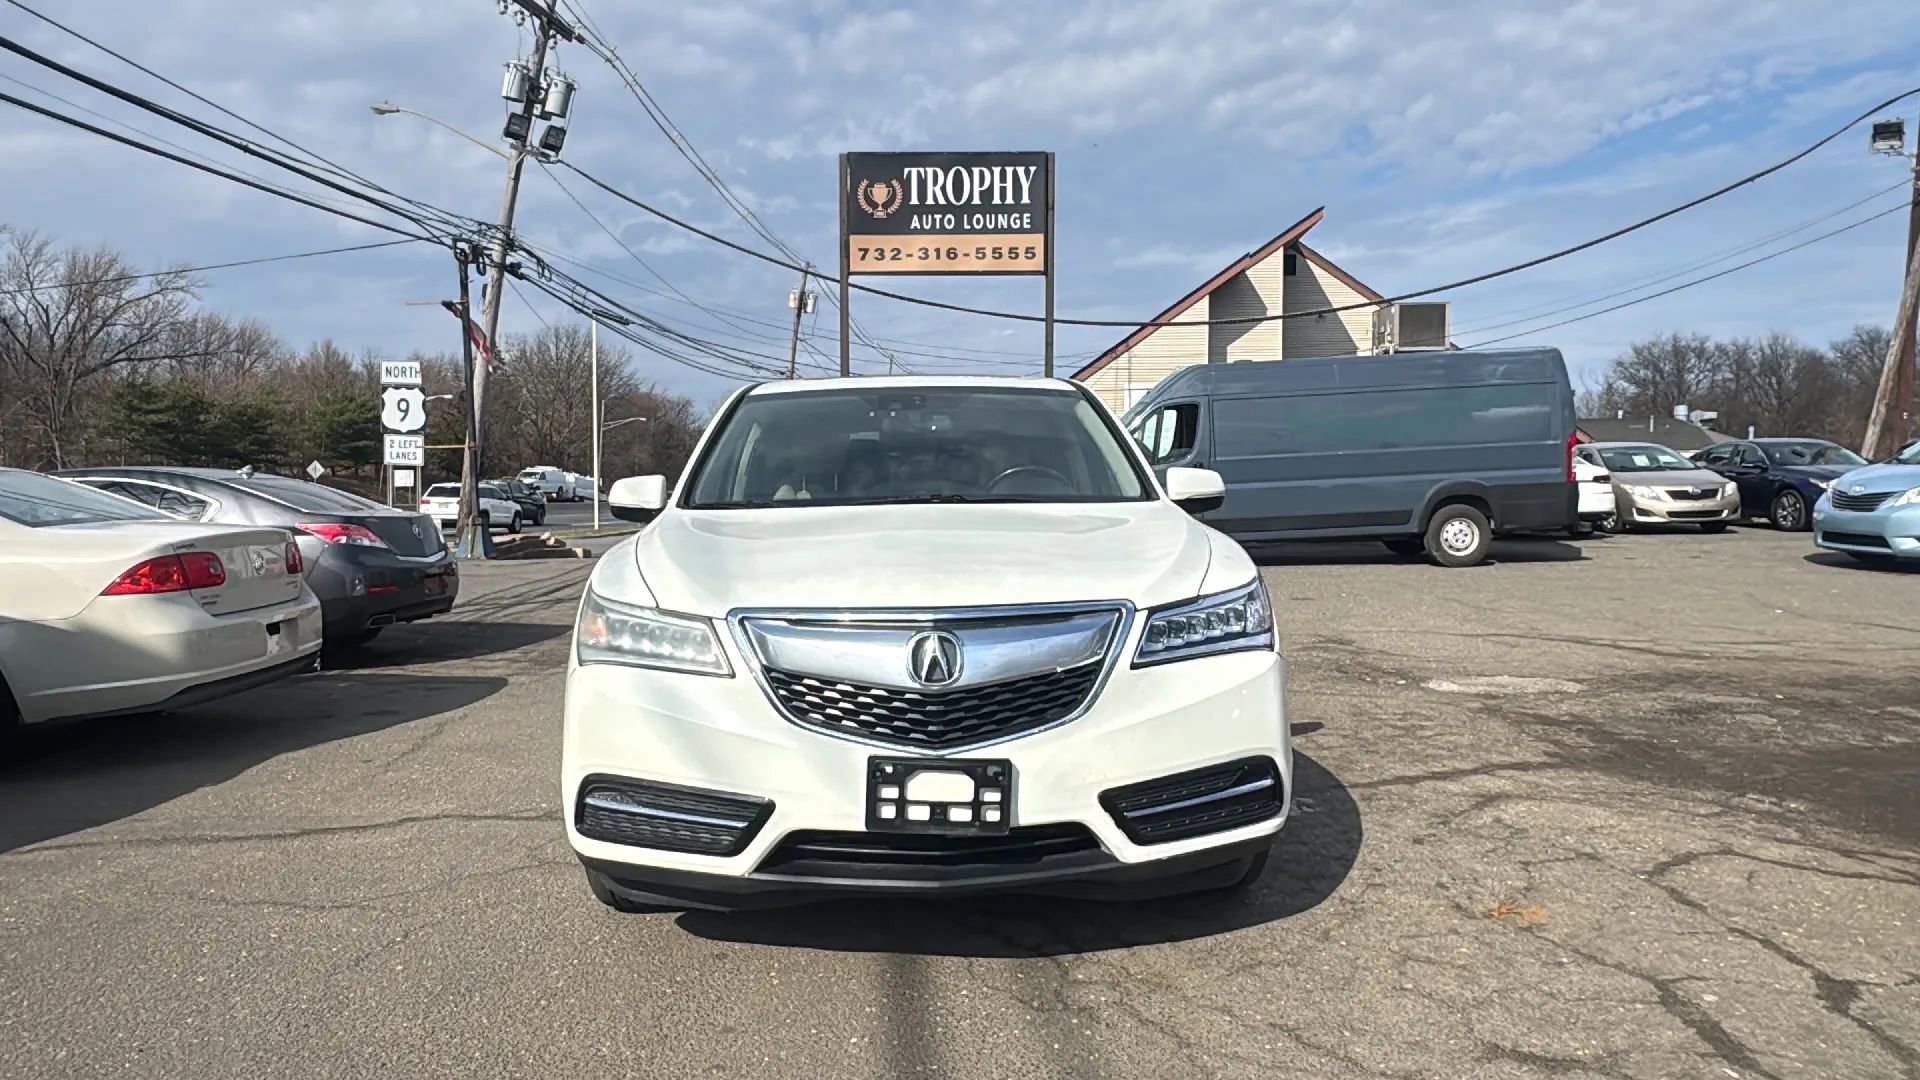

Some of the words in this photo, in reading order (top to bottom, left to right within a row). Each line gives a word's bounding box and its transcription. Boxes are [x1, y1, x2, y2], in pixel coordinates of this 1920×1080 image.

[903, 165, 1037, 206] TROPHY
[910, 213, 955, 230] AUTO
[963, 213, 1032, 230] LOUNGE
[857, 247, 1037, 261] 732-316-5555
[385, 366, 421, 378] NORTH
[397, 397, 410, 422] 9
[389, 439, 395, 449] 2
[398, 439, 419, 449] LEFT
[390, 451, 418, 461] LANES
